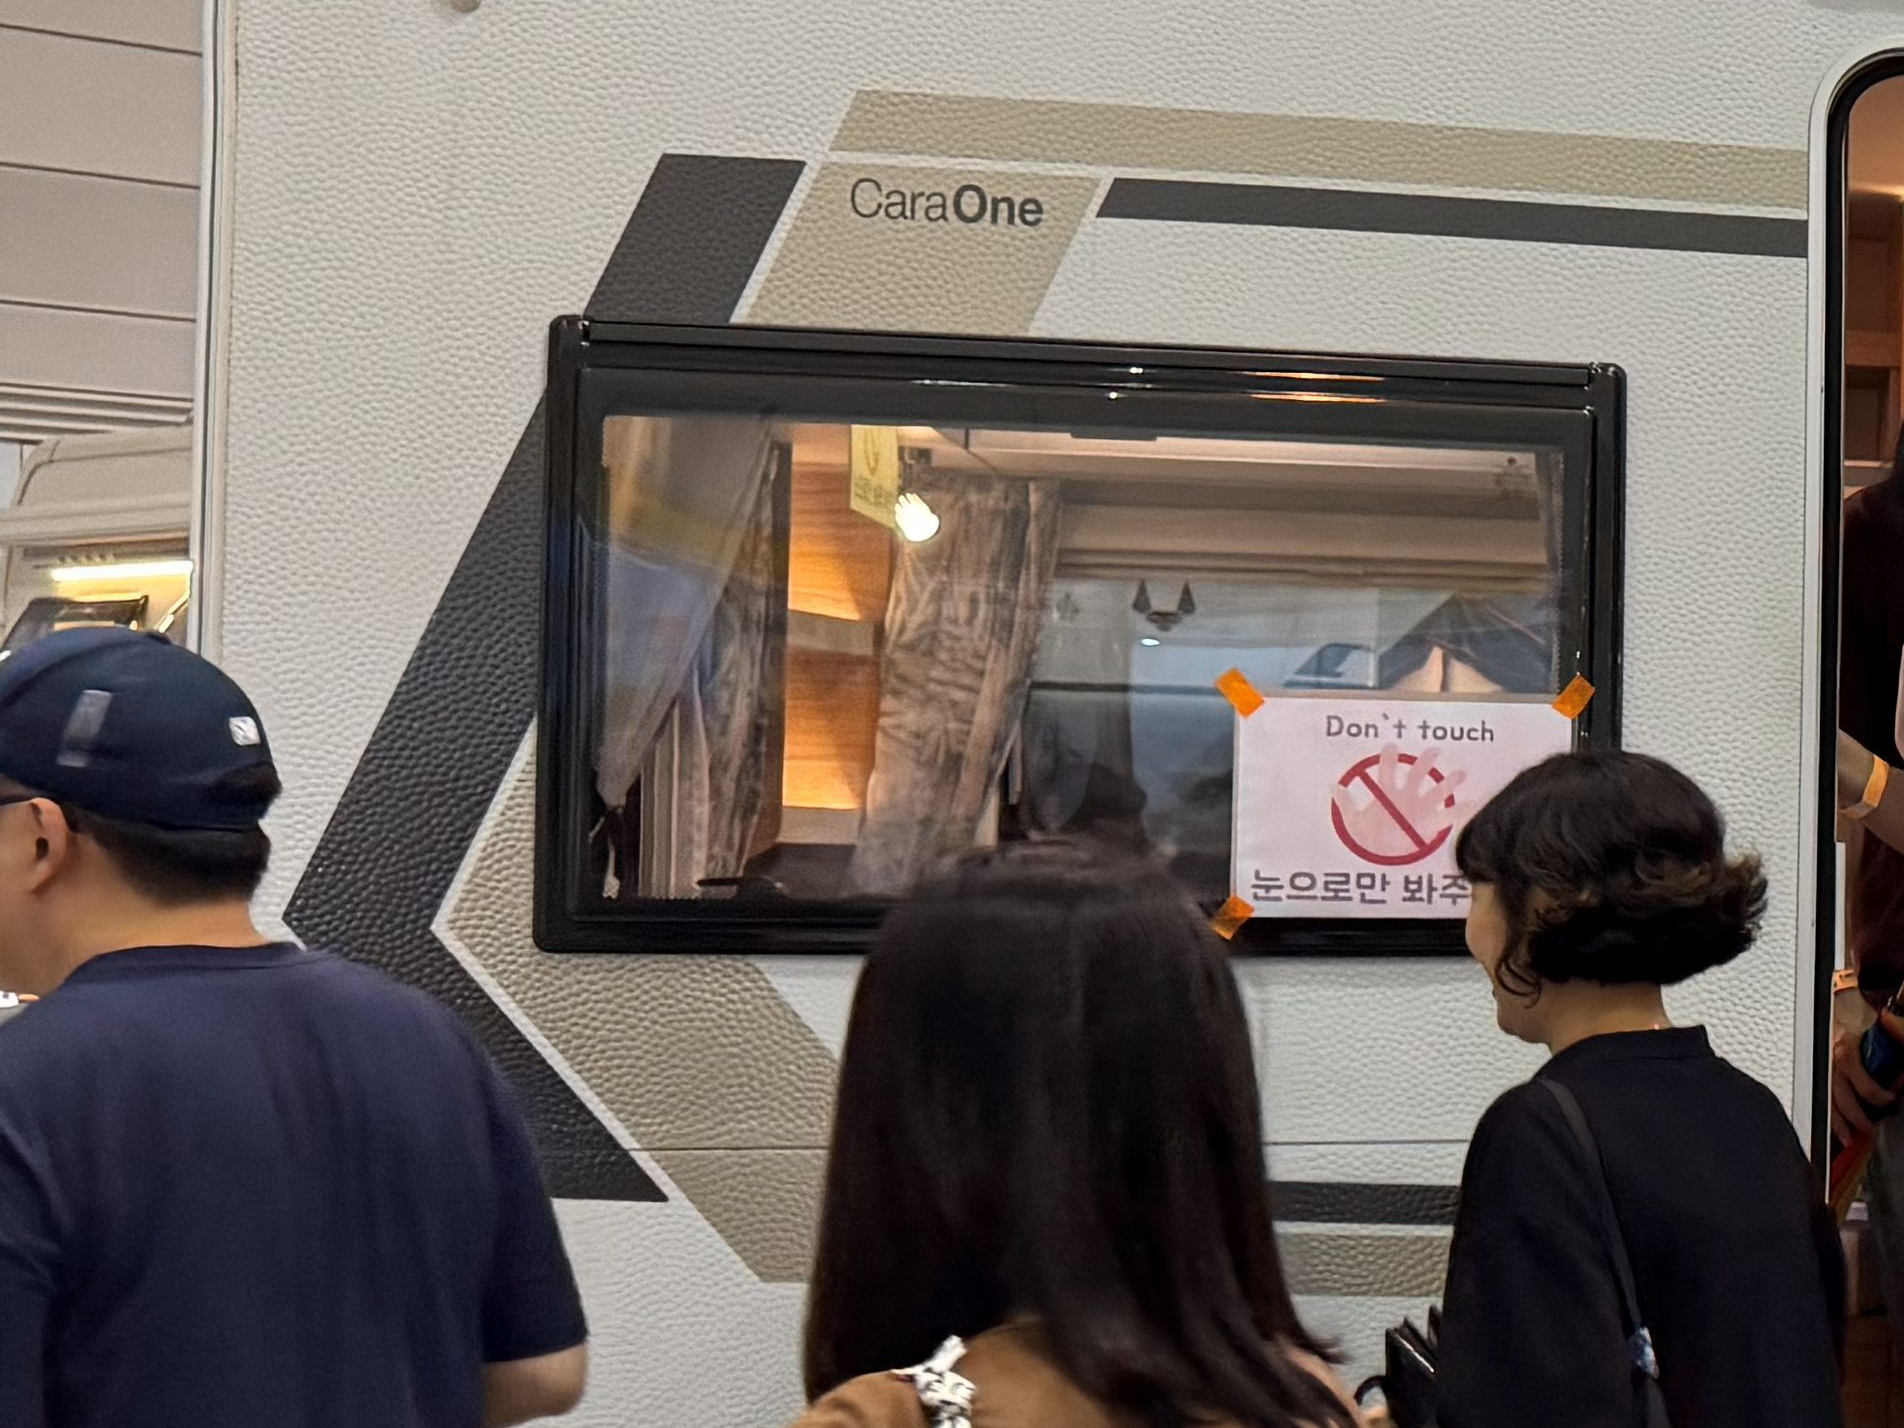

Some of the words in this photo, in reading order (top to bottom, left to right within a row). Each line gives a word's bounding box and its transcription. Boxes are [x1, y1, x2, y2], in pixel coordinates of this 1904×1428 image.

[850, 177, 1044, 227] CaraOne
[1418, 718, 1495, 743] touch
[1251, 870, 1391, 904] 눈으로만
